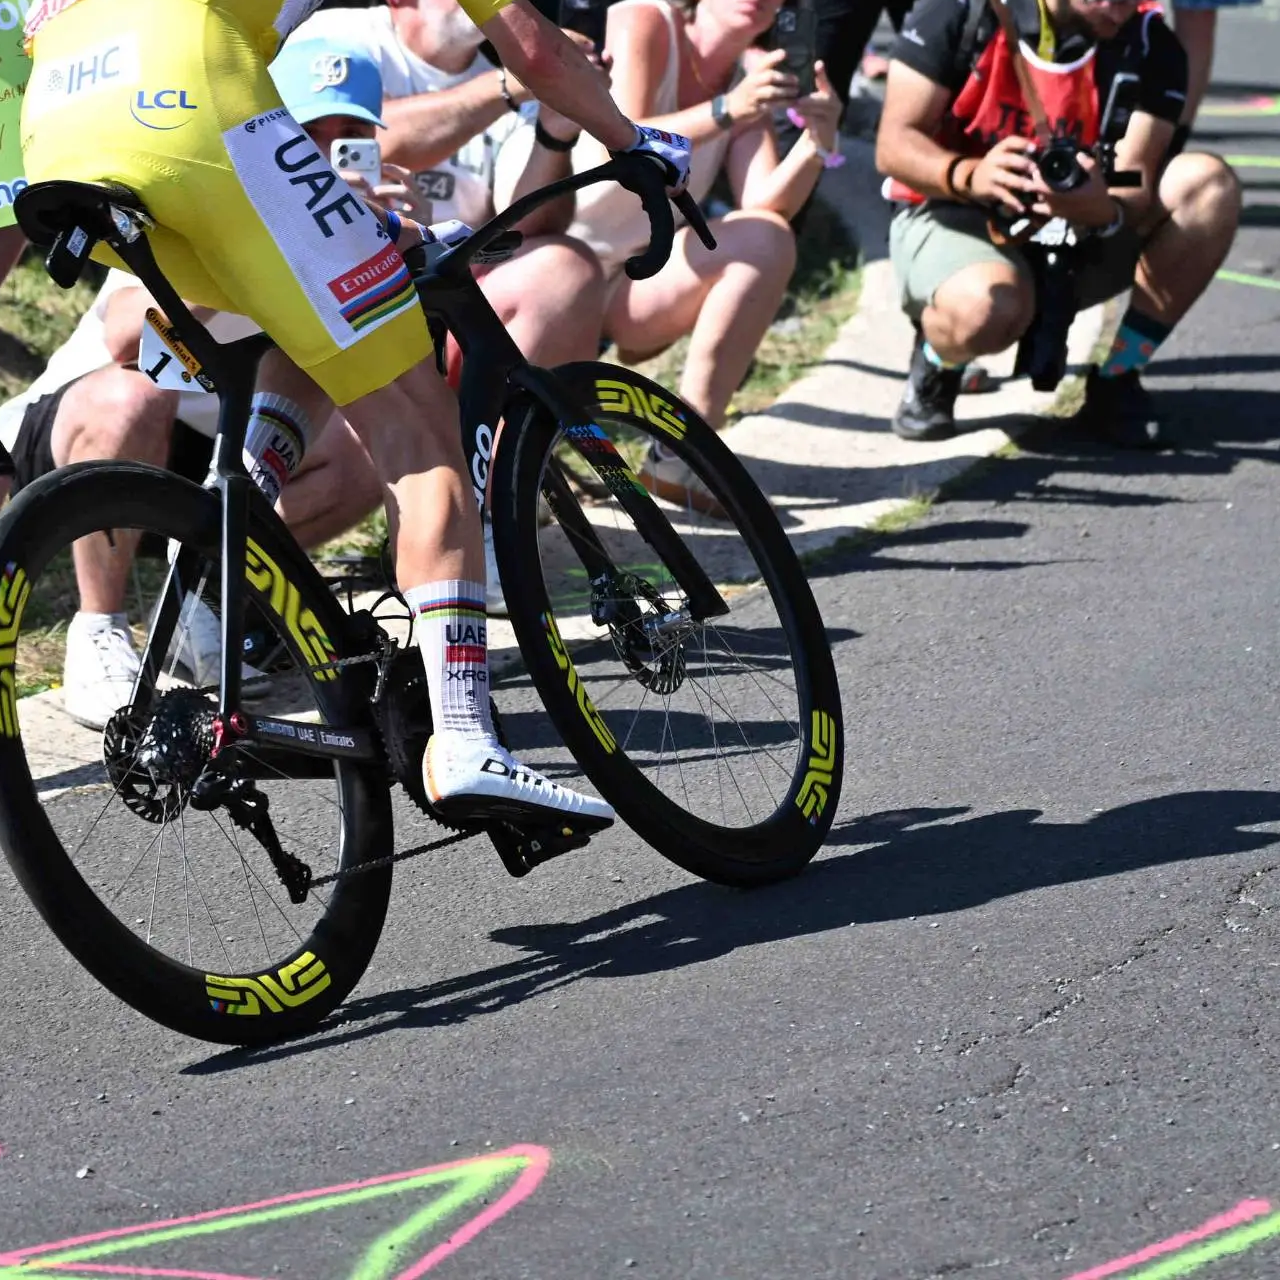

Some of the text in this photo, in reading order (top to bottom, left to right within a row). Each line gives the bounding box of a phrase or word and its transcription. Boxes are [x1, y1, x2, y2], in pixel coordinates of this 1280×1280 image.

[66, 46, 120, 95] IHC
[136, 89, 198, 110] LCL
[274, 133, 366, 239] UAE
[340, 250, 402, 295] Emirates
[145, 351, 173, 384] 1
[445, 623, 487, 647] UAE
[297, 727, 317, 742] UAE
